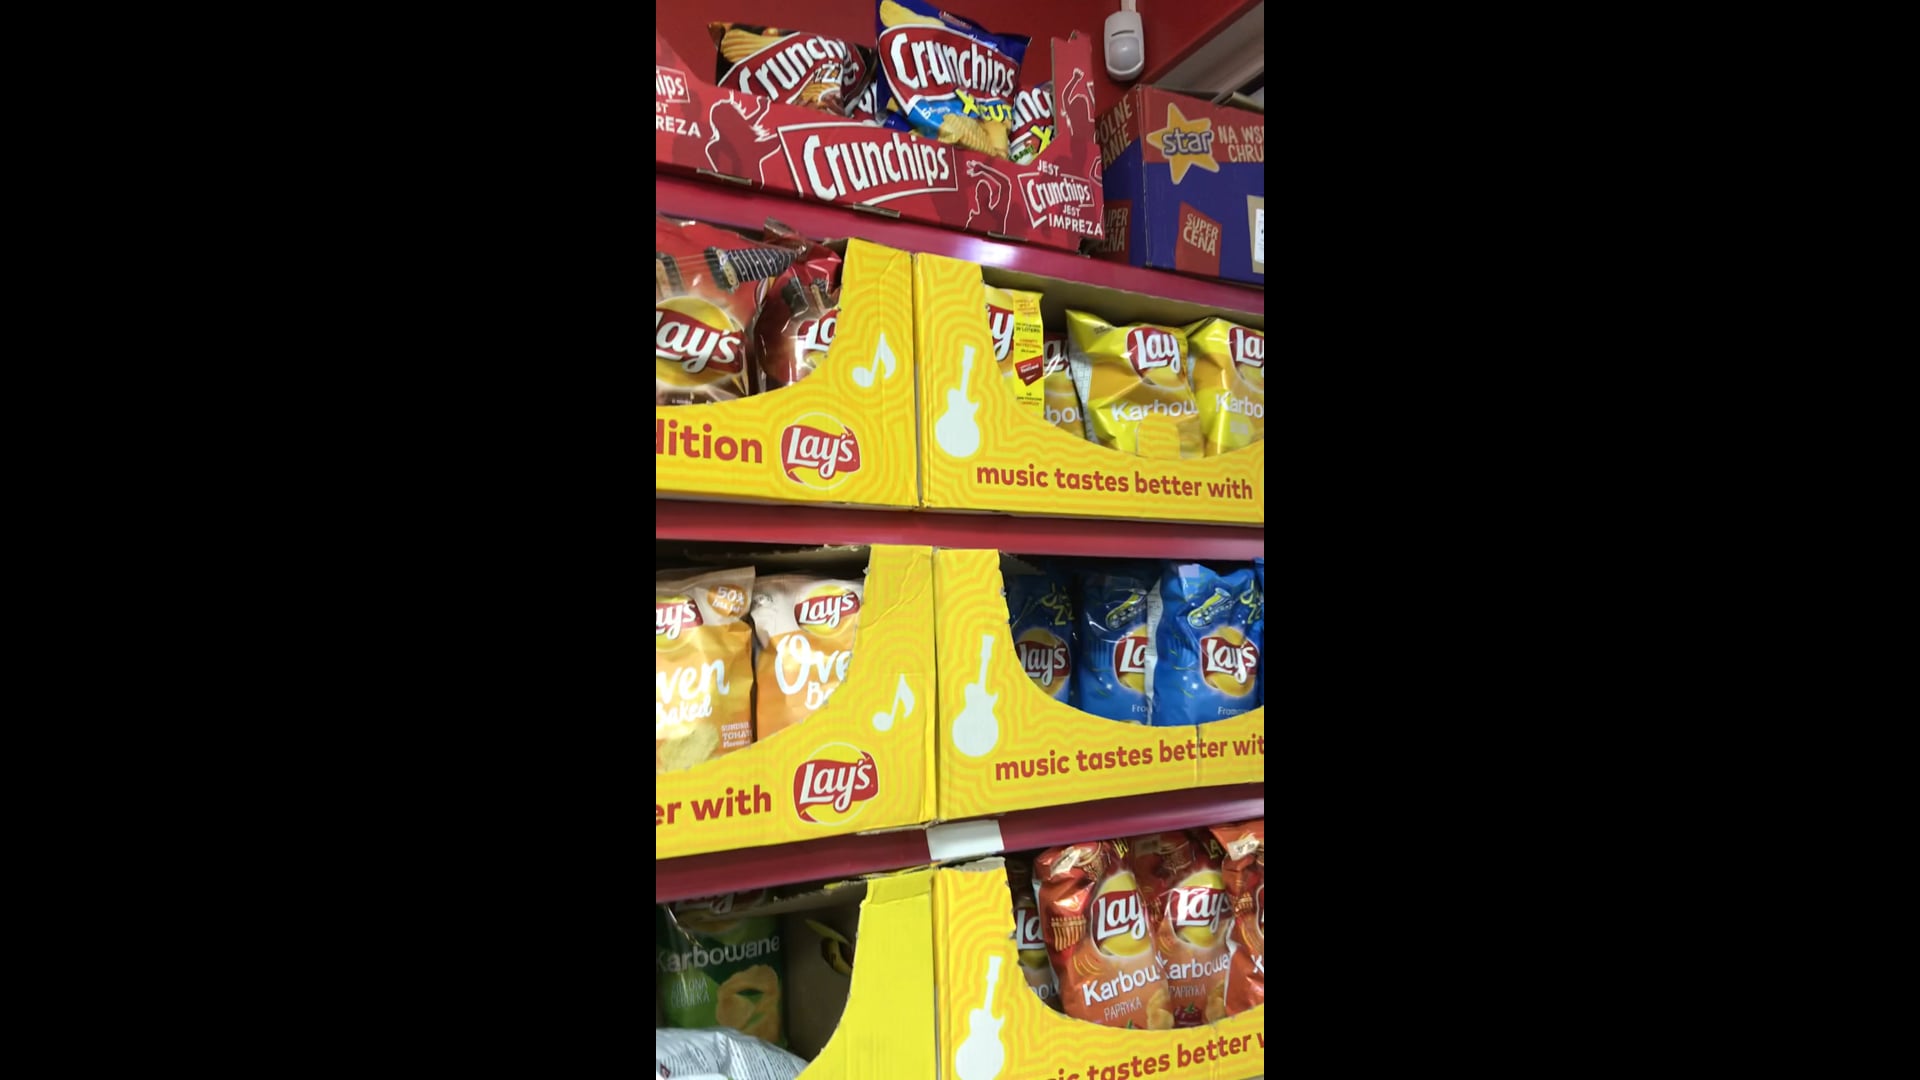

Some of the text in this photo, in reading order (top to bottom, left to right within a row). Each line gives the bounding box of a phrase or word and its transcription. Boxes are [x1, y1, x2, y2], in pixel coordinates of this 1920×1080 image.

[890, 33, 1015, 99] Crunchips
[1163, 128, 1212, 154] star
[1218, 126, 1238, 145] NA
[803, 133, 949, 201] Crunchips
[1037, 159, 1060, 177] JEST
[1026, 177, 1090, 213] Crunchips
[1062, 204, 1080, 217] JEST
[1048, 213, 1103, 236] IMPREZA
[1185, 212, 1219, 241] SUPER
[787, 426, 855, 479] Lay's
[976, 463, 1253, 500] music tastes better with
[798, 591, 857, 628] Lay's
[1205, 638, 1258, 684] Lay's
[995, 749, 1070, 781] music
[1076, 746, 1153, 772] tastes
[1159, 739, 1228, 763] better
[690, 784, 772, 821] with
[799, 759, 873, 812] Lay's
[1103, 995, 1142, 1021] PAPRYKA
[1177, 1034, 1252, 1068] better
